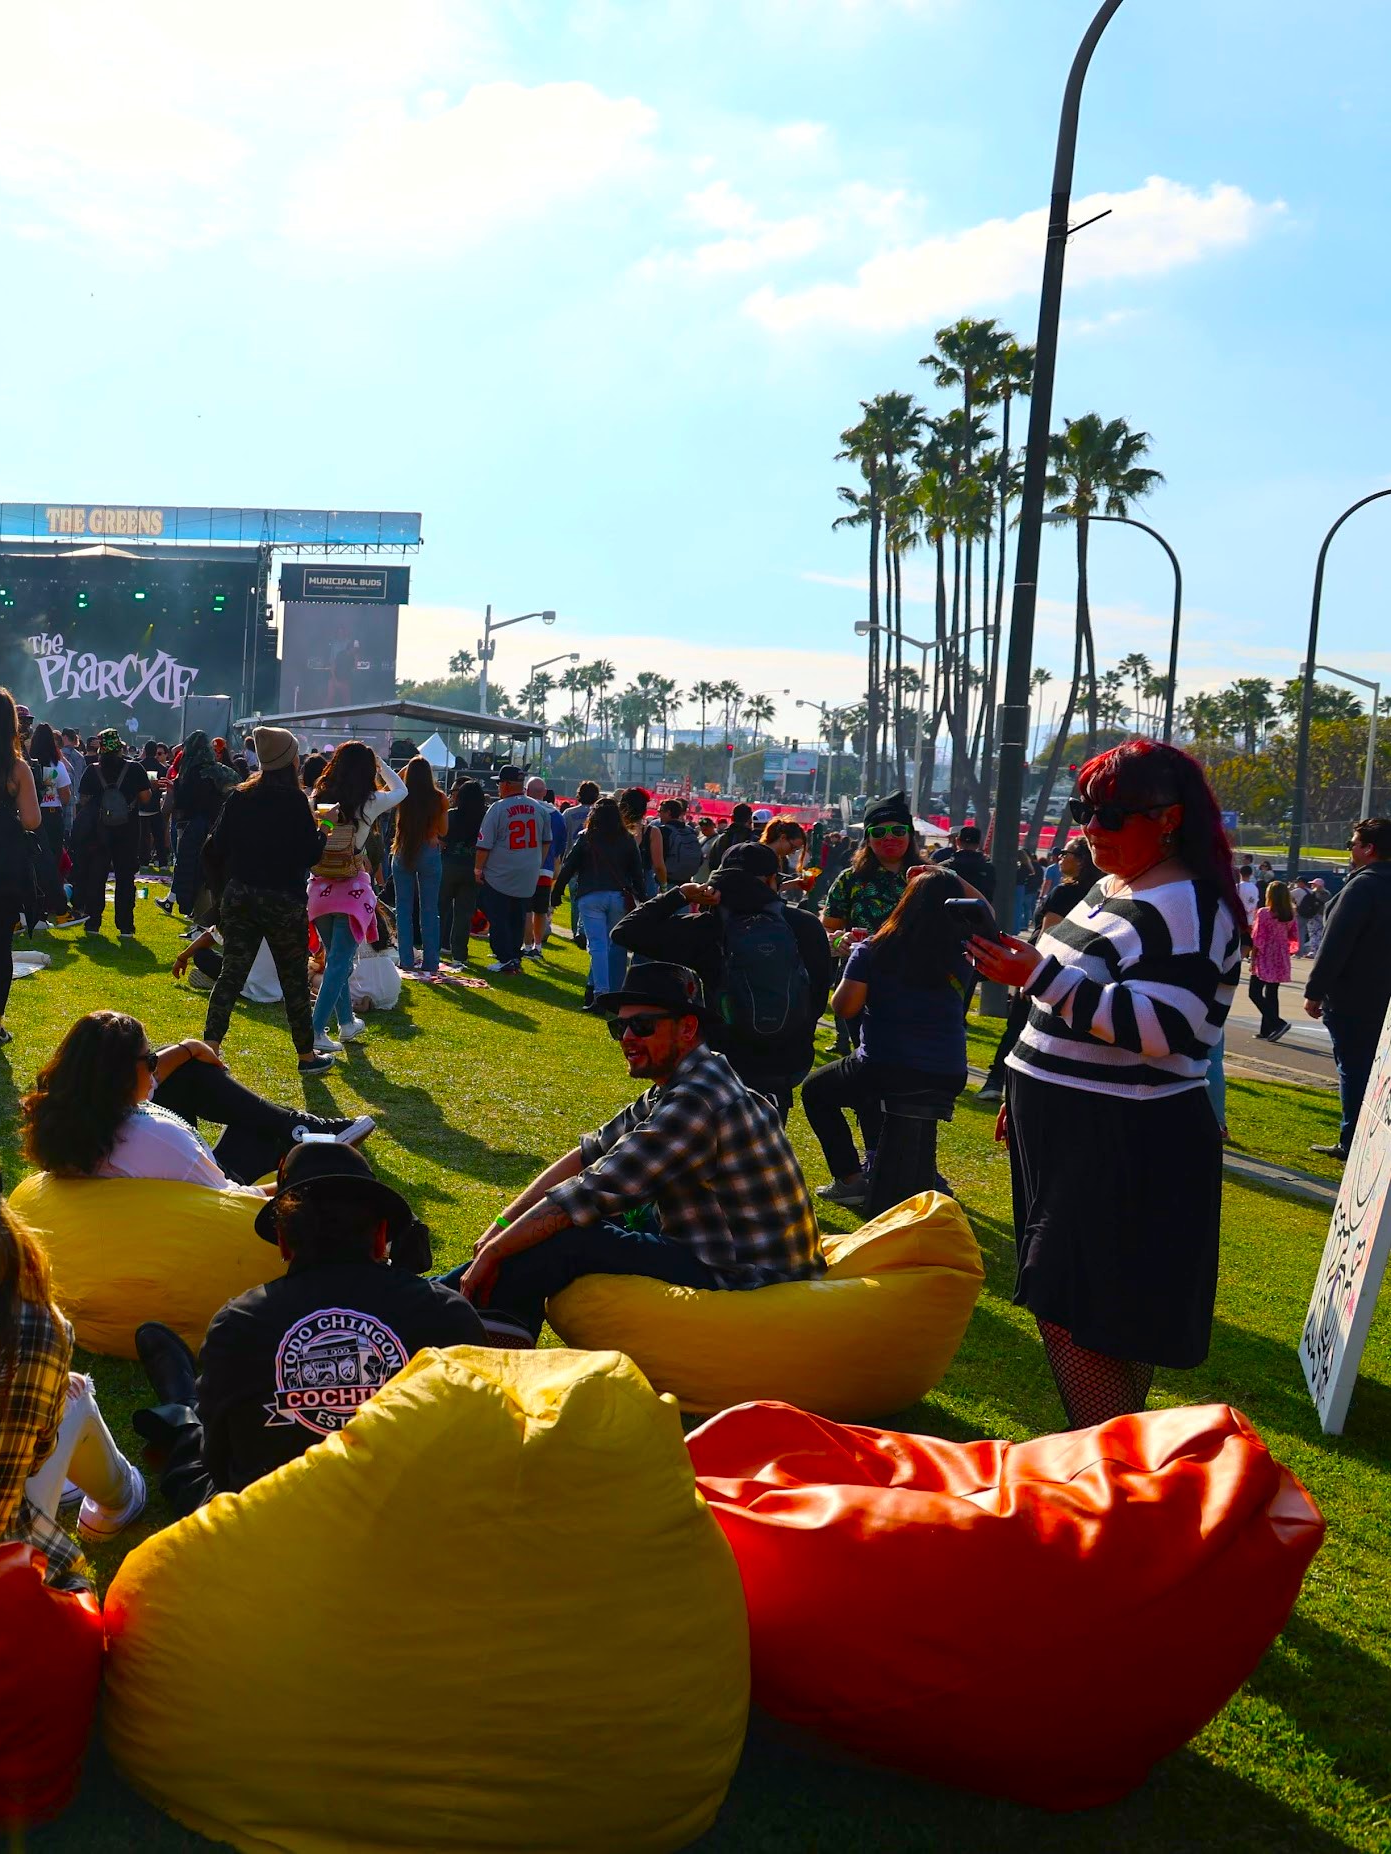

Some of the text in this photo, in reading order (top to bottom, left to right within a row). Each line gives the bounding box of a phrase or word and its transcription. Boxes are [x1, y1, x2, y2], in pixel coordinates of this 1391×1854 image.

[46, 508, 163, 535] THE GREENS
[308, 577, 382, 586] MUNICIPAL BUDS
[655, 786, 682, 797] EXIT
[506, 804, 536, 818] JOYNER
[508, 818, 538, 850] 21
[283, 1315, 402, 1378] TODO CHINGON
